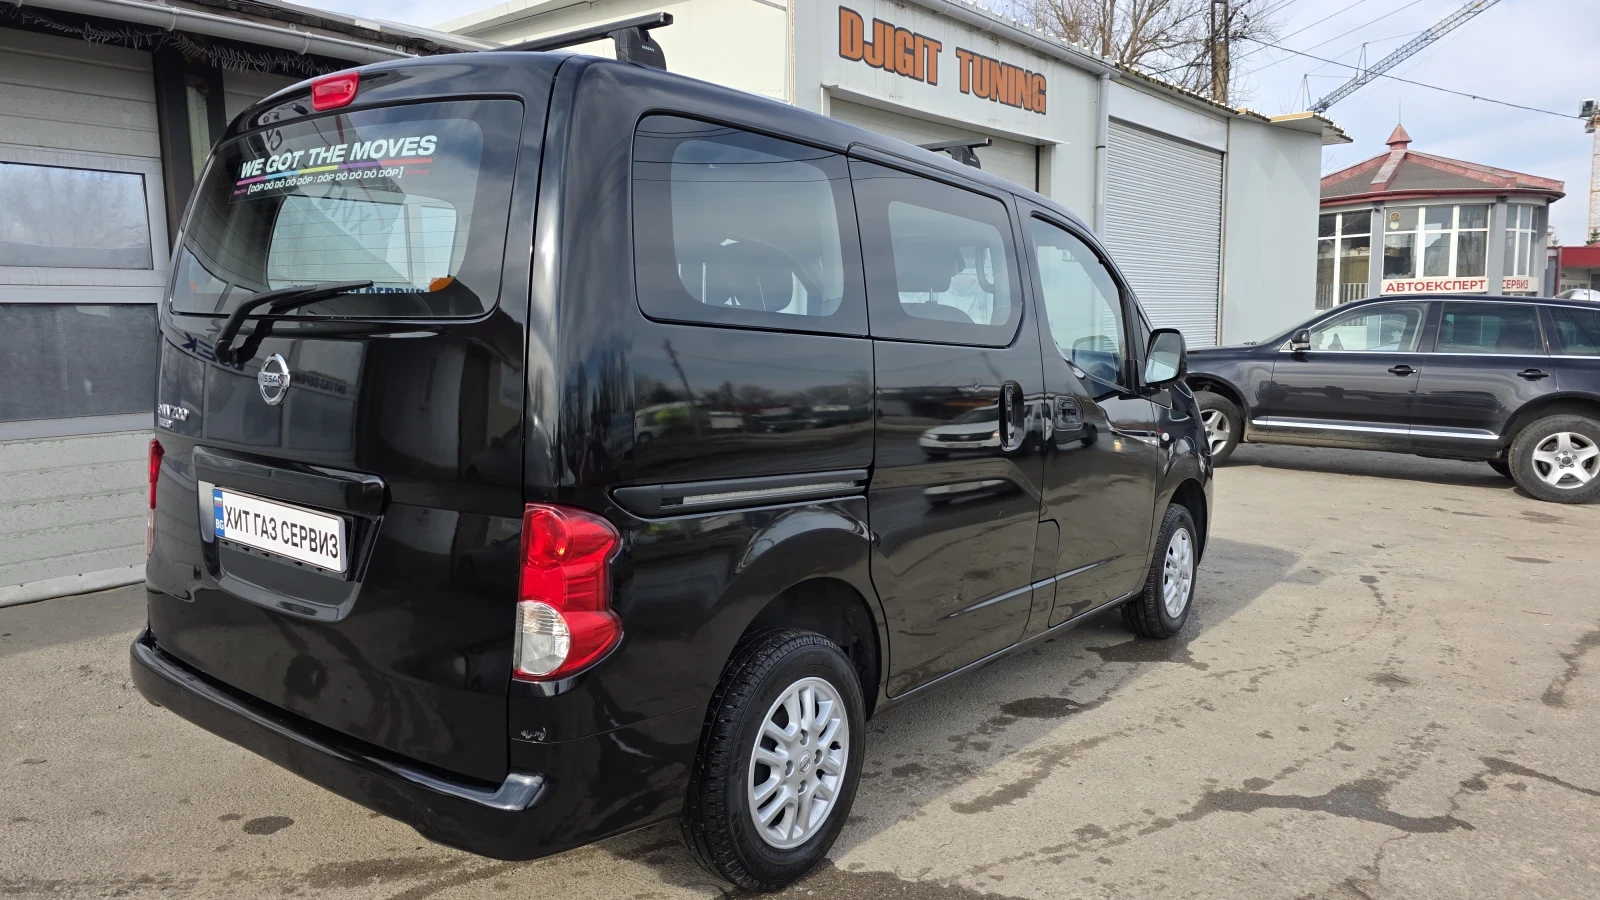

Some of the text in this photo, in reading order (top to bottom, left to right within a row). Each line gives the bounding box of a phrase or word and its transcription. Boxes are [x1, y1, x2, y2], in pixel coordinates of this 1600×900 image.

[839, 5, 1046, 115] DJIGIT TUNING
[240, 135, 437, 179] WE GOT THE MOVES
[1385, 279, 1485, 292] АВТОЕКСПЕРТ
[215, 518, 225, 530] BG
[225, 505, 338, 558] ХИТ ГАЗ СЕРВИЗ
